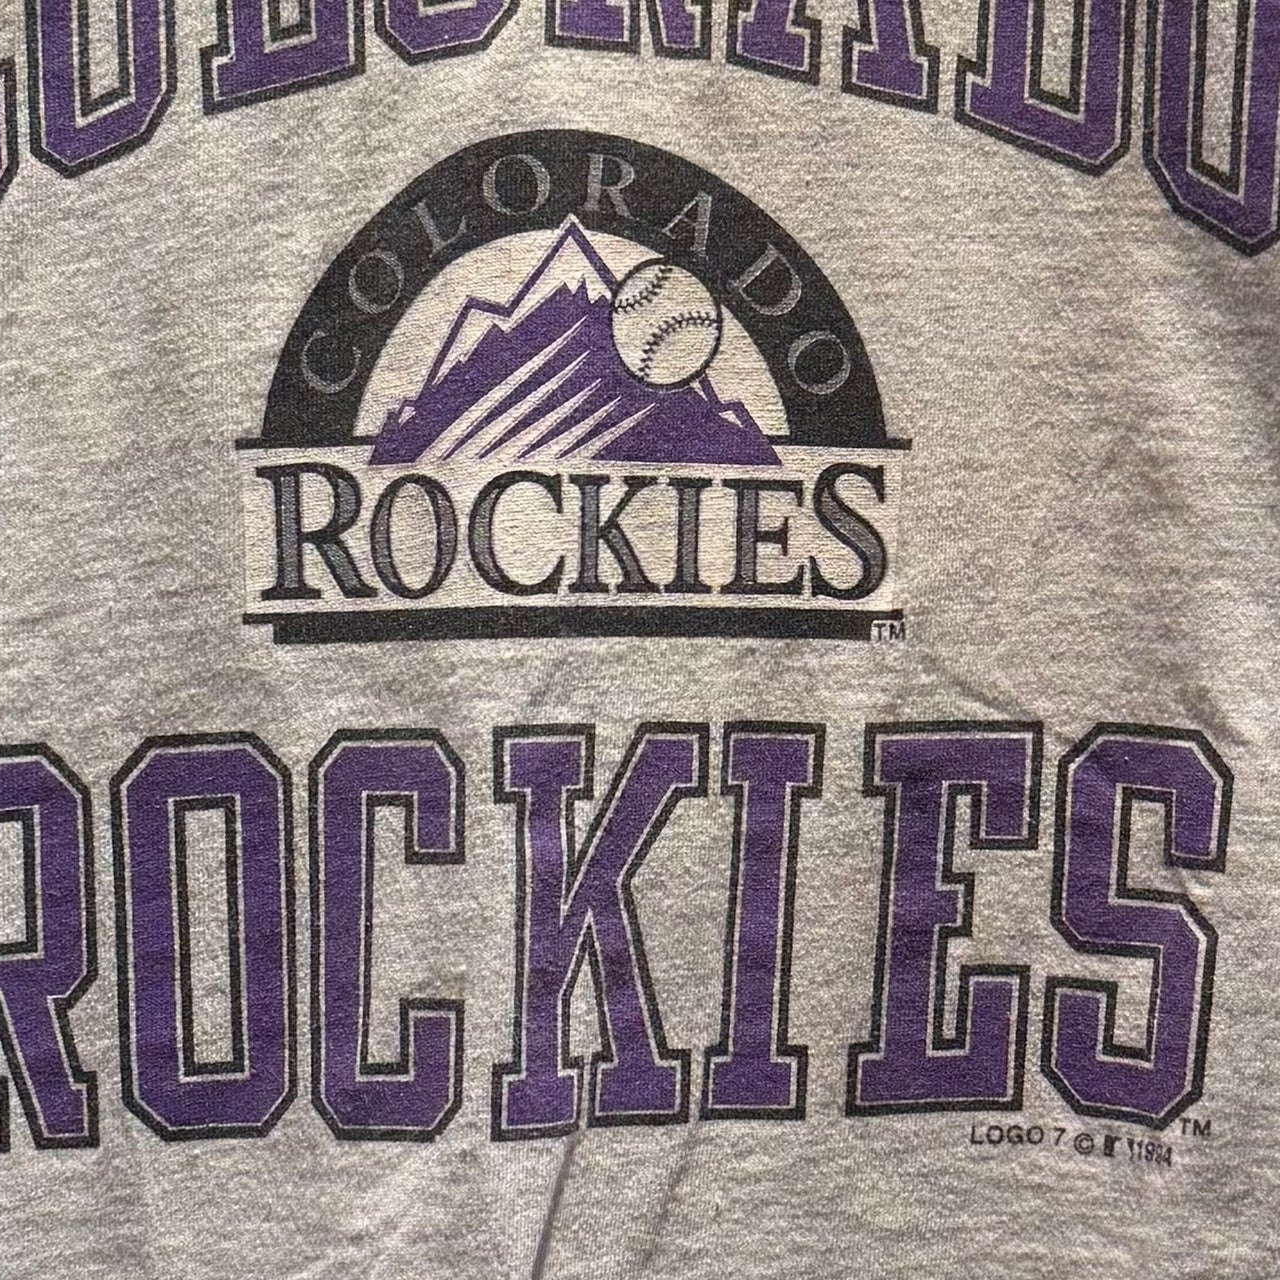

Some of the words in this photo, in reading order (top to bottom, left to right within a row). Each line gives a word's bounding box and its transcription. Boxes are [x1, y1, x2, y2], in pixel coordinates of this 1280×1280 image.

[300, 151, 852, 394] COLORADO
[256, 462, 889, 601] ROCKIES
[970, 1125, 1045, 1146] LOGO
[1053, 1128, 1067, 1147] 7
